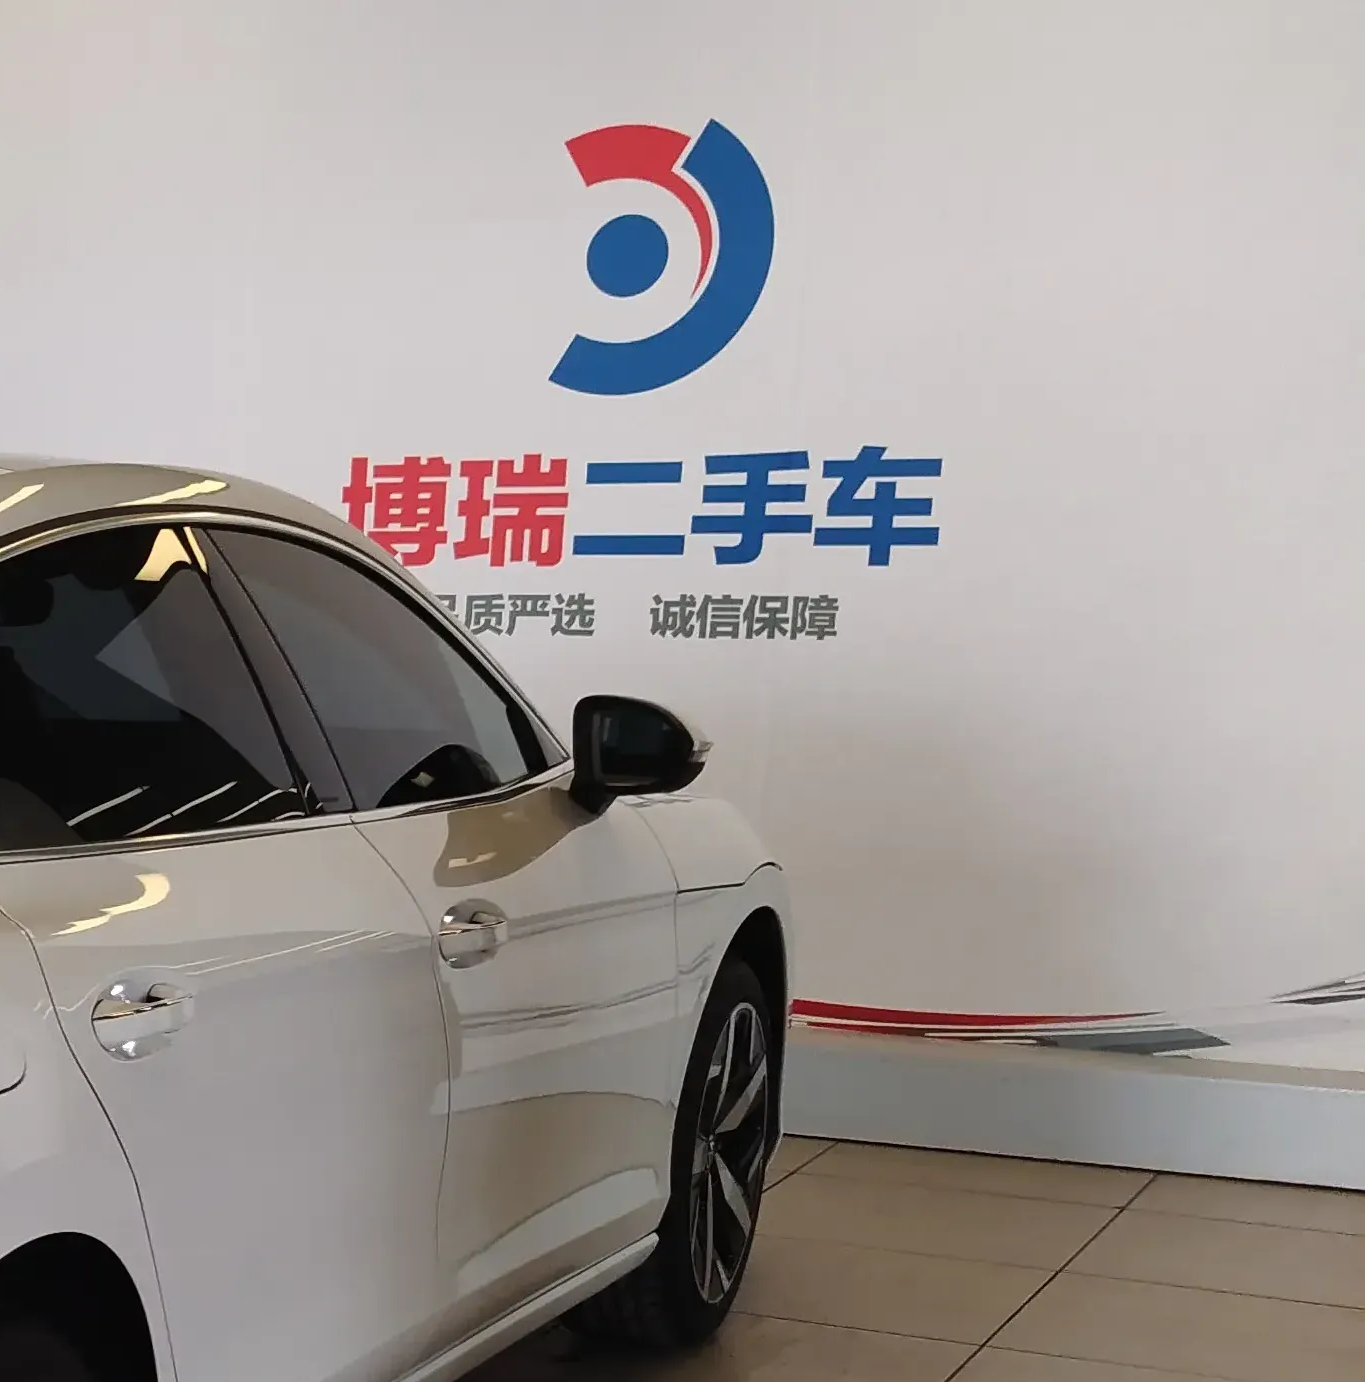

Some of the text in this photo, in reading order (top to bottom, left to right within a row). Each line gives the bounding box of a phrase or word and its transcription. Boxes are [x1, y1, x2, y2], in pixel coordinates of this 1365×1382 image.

[342, 445, 943, 567] 博瑞二手车
[649, 594, 839, 640] 诚信保障
